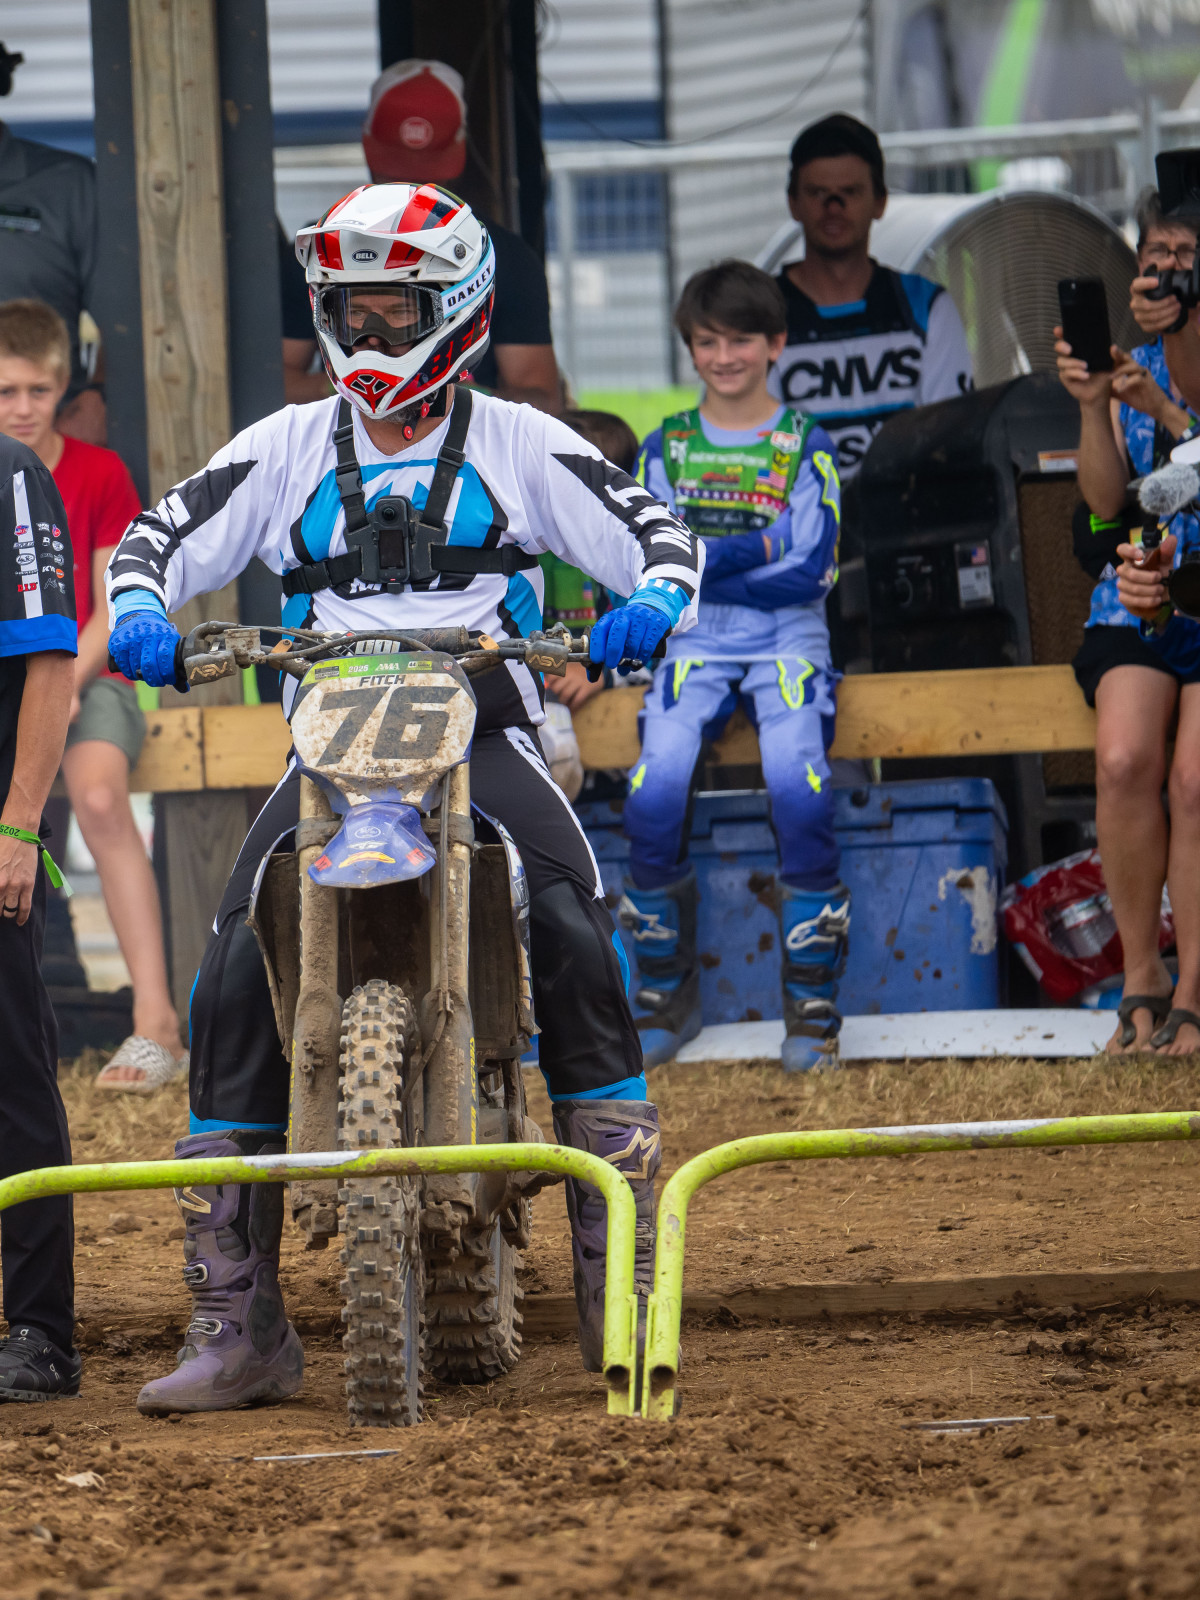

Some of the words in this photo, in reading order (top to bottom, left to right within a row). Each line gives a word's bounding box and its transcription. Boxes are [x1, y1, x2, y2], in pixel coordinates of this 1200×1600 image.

[355, 252, 375, 260] BELL
[447, 264, 492, 308] OAKLEY
[781, 346, 921, 404] CNVS
[529, 654, 565, 668] ASV
[189, 661, 228, 680] ASV
[359, 675, 406, 687] FITCH
[315, 686, 460, 767] 76
[0, 824, 21, 837] 2025
